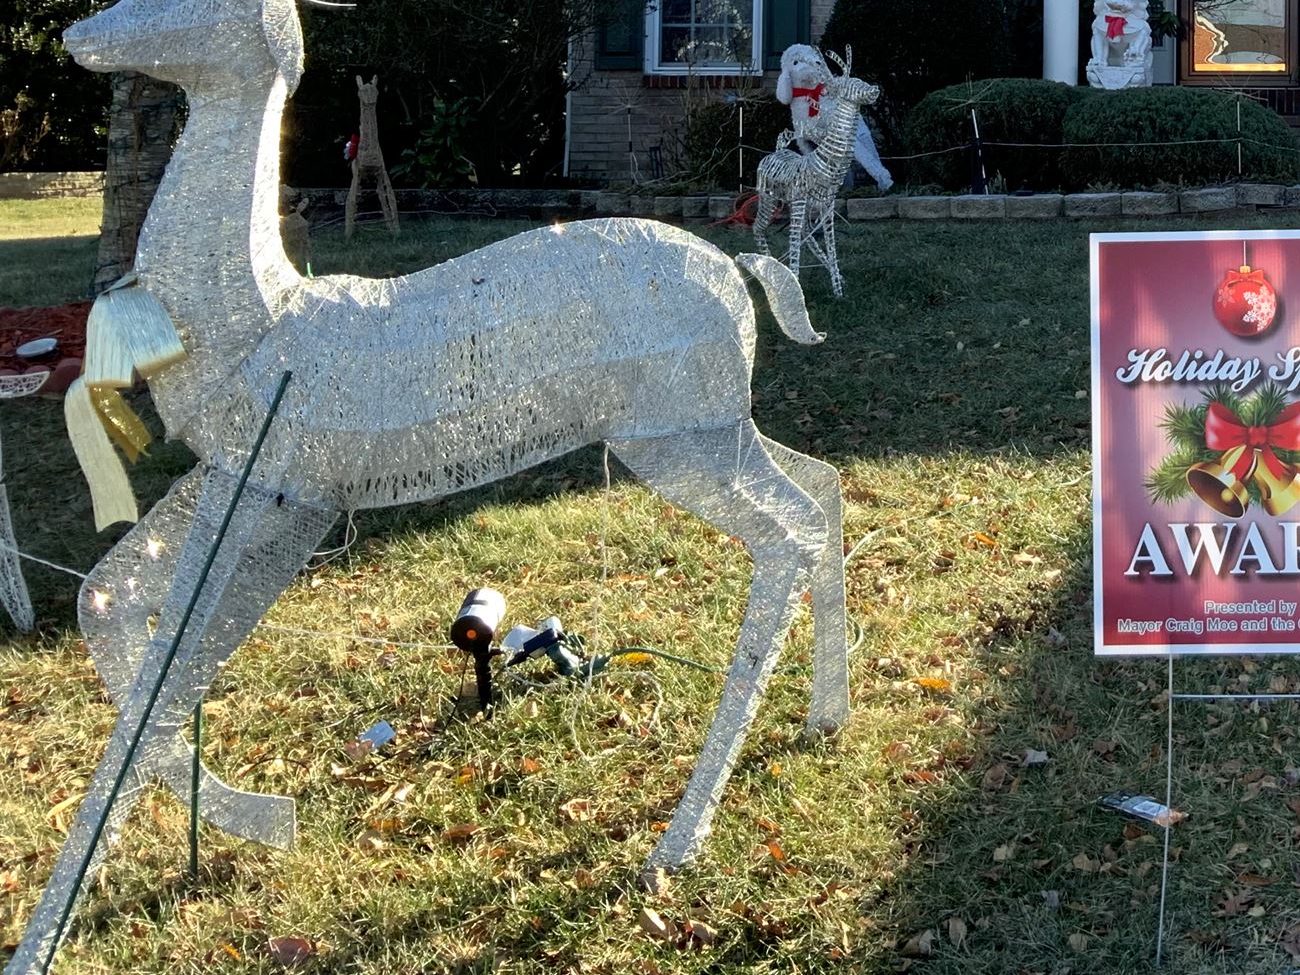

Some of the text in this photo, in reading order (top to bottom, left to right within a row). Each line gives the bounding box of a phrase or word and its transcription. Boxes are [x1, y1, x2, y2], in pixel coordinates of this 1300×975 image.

[1116, 348, 1261, 392] Holiday
[1204, 600, 1297, 616] Presented by
[1117, 618, 1163, 635] Mayor
[1165, 618, 1203, 634] Craig
[1207, 618, 1238, 631] Moe
[1241, 618, 1268, 631] and
[1271, 617, 1295, 631] the
